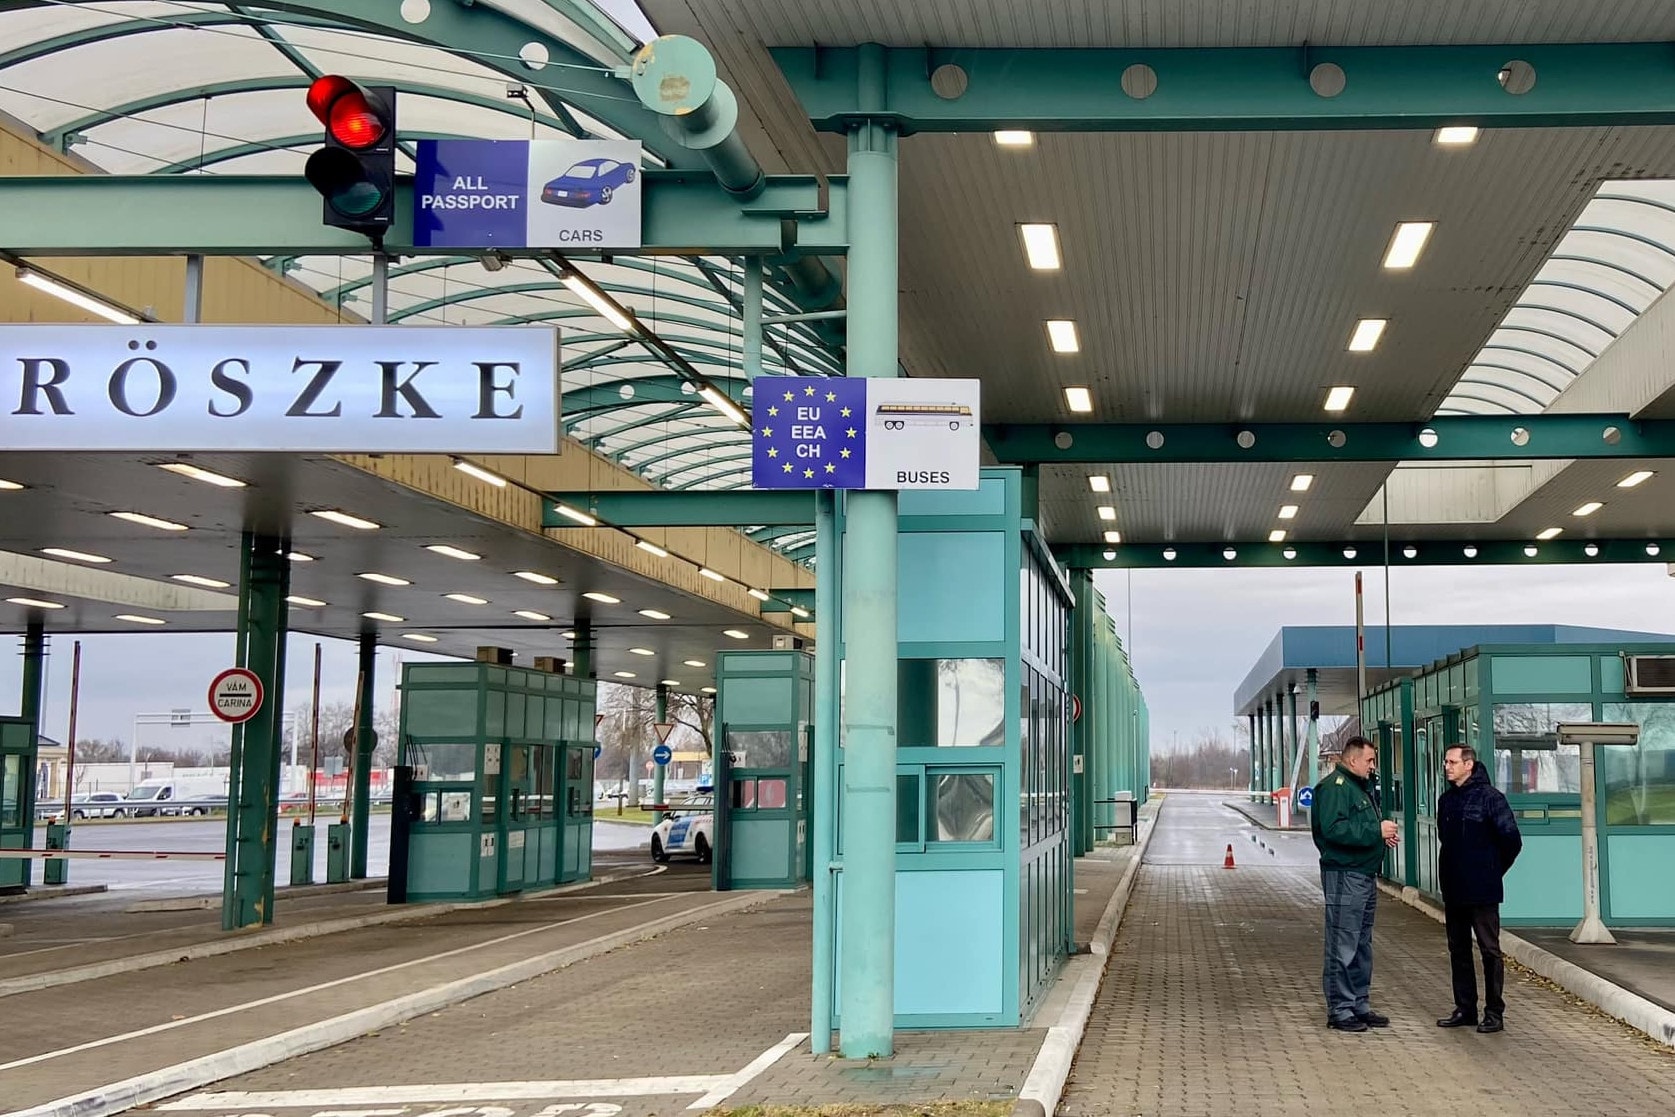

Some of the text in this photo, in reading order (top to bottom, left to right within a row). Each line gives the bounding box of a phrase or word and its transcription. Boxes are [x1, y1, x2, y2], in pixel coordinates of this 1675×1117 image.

[453, 176, 488, 190] ALL
[421, 194, 519, 210] PASSPORT
[558, 229, 603, 242] CARS
[11, 339, 524, 419] RÖSZKE
[797, 406, 820, 421] EU
[791, 425, 827, 440] EEA
[796, 443, 821, 459] CH
[897, 471, 950, 484] BUSES
[226, 681, 247, 692] VÁM
[217, 698, 252, 708] CARINA
